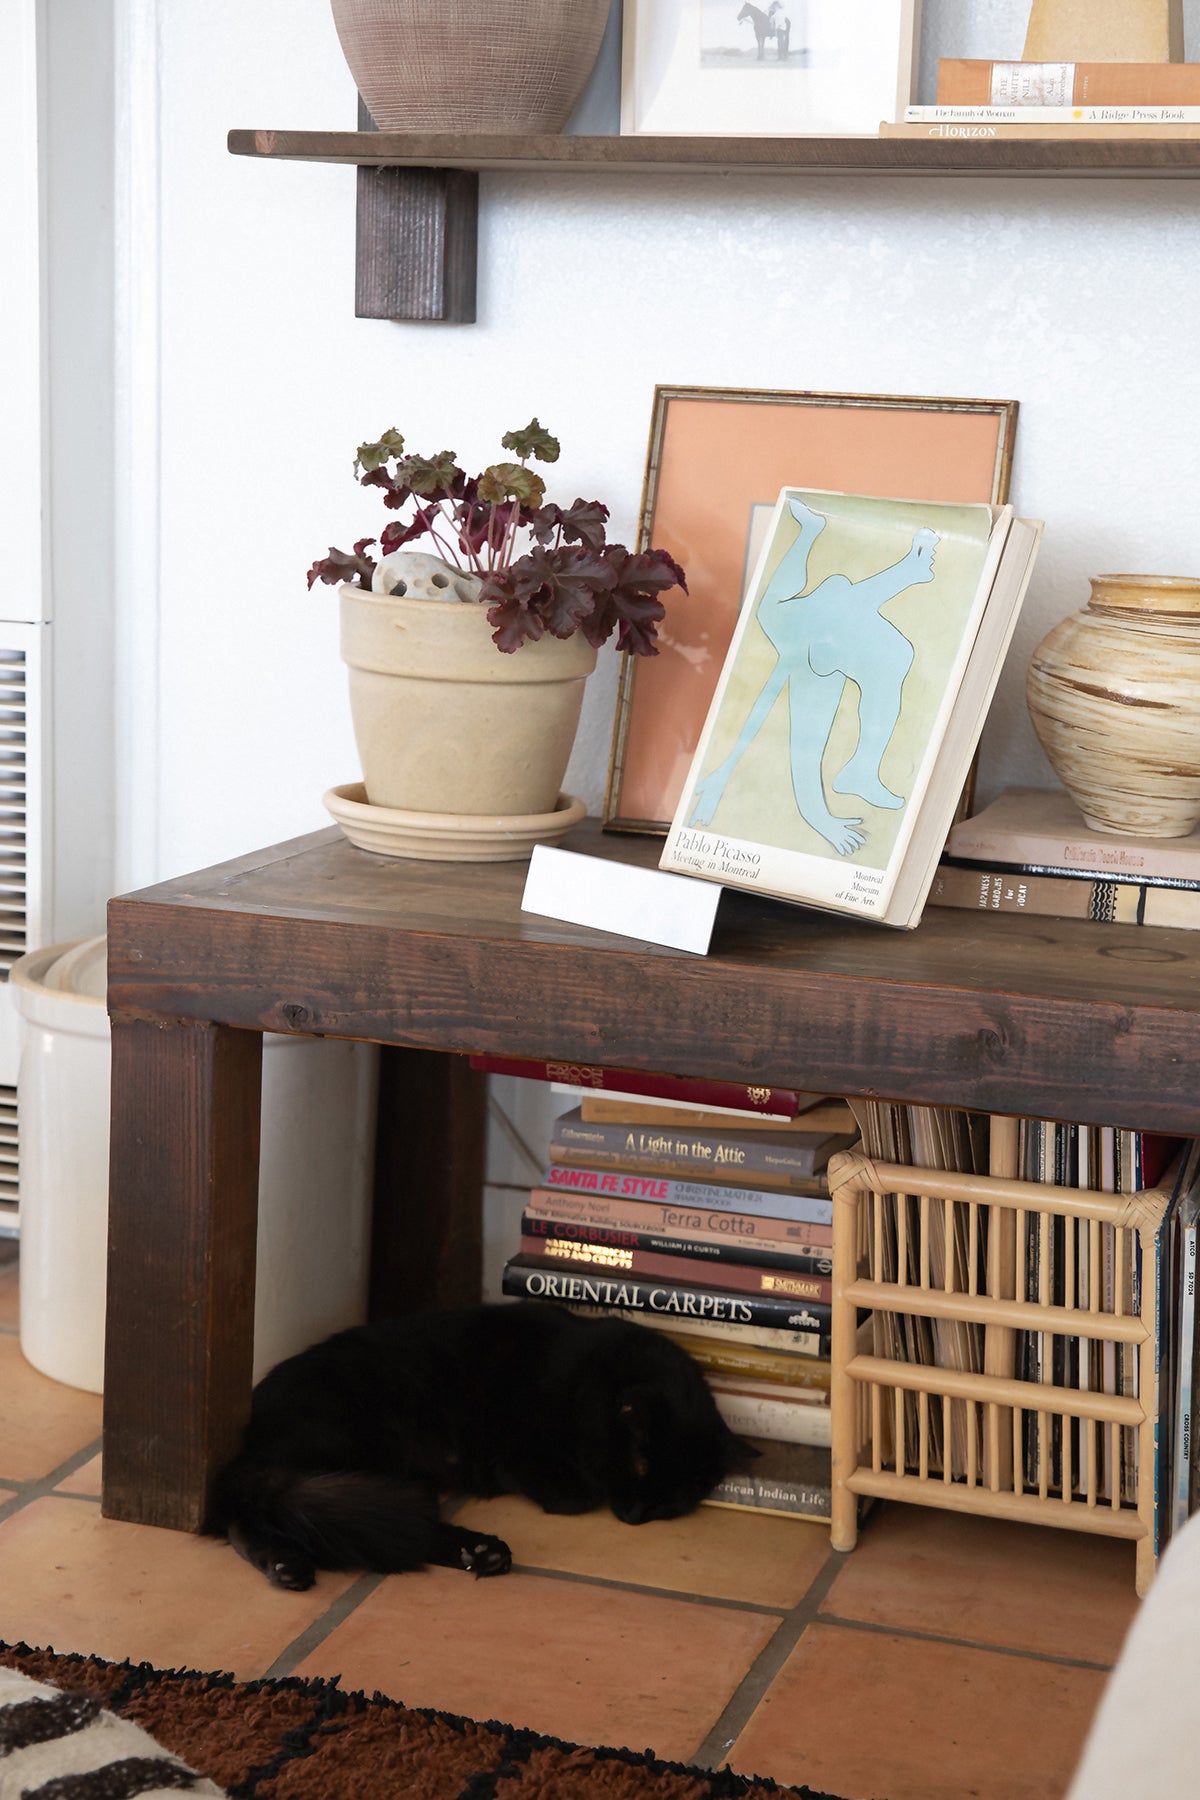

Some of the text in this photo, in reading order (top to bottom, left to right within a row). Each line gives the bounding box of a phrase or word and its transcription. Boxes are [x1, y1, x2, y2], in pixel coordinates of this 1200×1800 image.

[999, 78, 1008, 97] THE
[1011, 70, 1019, 105] WHITE
[1022, 77, 1030, 98] NILE
[935, 109, 949, 117] The
[950, 109, 975, 119] Family
[976, 109, 984, 117] of
[1088, 110, 1185, 121] A Ridge Press Book
[674, 831, 761, 866] Pablo Picasso
[671, 850, 761, 880] Meeting in Montreal
[853, 871, 884, 884] Montreal
[835, 890, 876, 906] of Fine Arts
[851, 882, 880, 896] Museum
[979, 874, 991, 908] JAPANESE
[992, 877, 1003, 909] GARDENS
[1005, 888, 1014, 900] for
[1016, 884, 1028, 907] TODAY
[625, 1133, 636, 1152] A
[639, 1134, 673, 1156] Light
[675, 1139, 689, 1156] in
[691, 1142, 712, 1160] the
[714, 1144, 746, 1165] Attic
[548, 1168, 670, 1199] SANTA FE STYLE
[675, 1183, 721, 1197] CHRISTINE
[545, 1196, 586, 1212] Anthony
[661, 1208, 756, 1235] Terra Cotta
[531, 1220, 640, 1246] LE CORBUSIER
[651, 1239, 682, 1251] WILLIAM
[694, 1245, 720, 1255] CURTIS
[1188, 1271, 1194, 1280] SD
[525, 1272, 645, 1308] ORIENTAL
[649, 1289, 752, 1322] CARPETS
[715, 1482, 825, 1506] erican Indian Life
